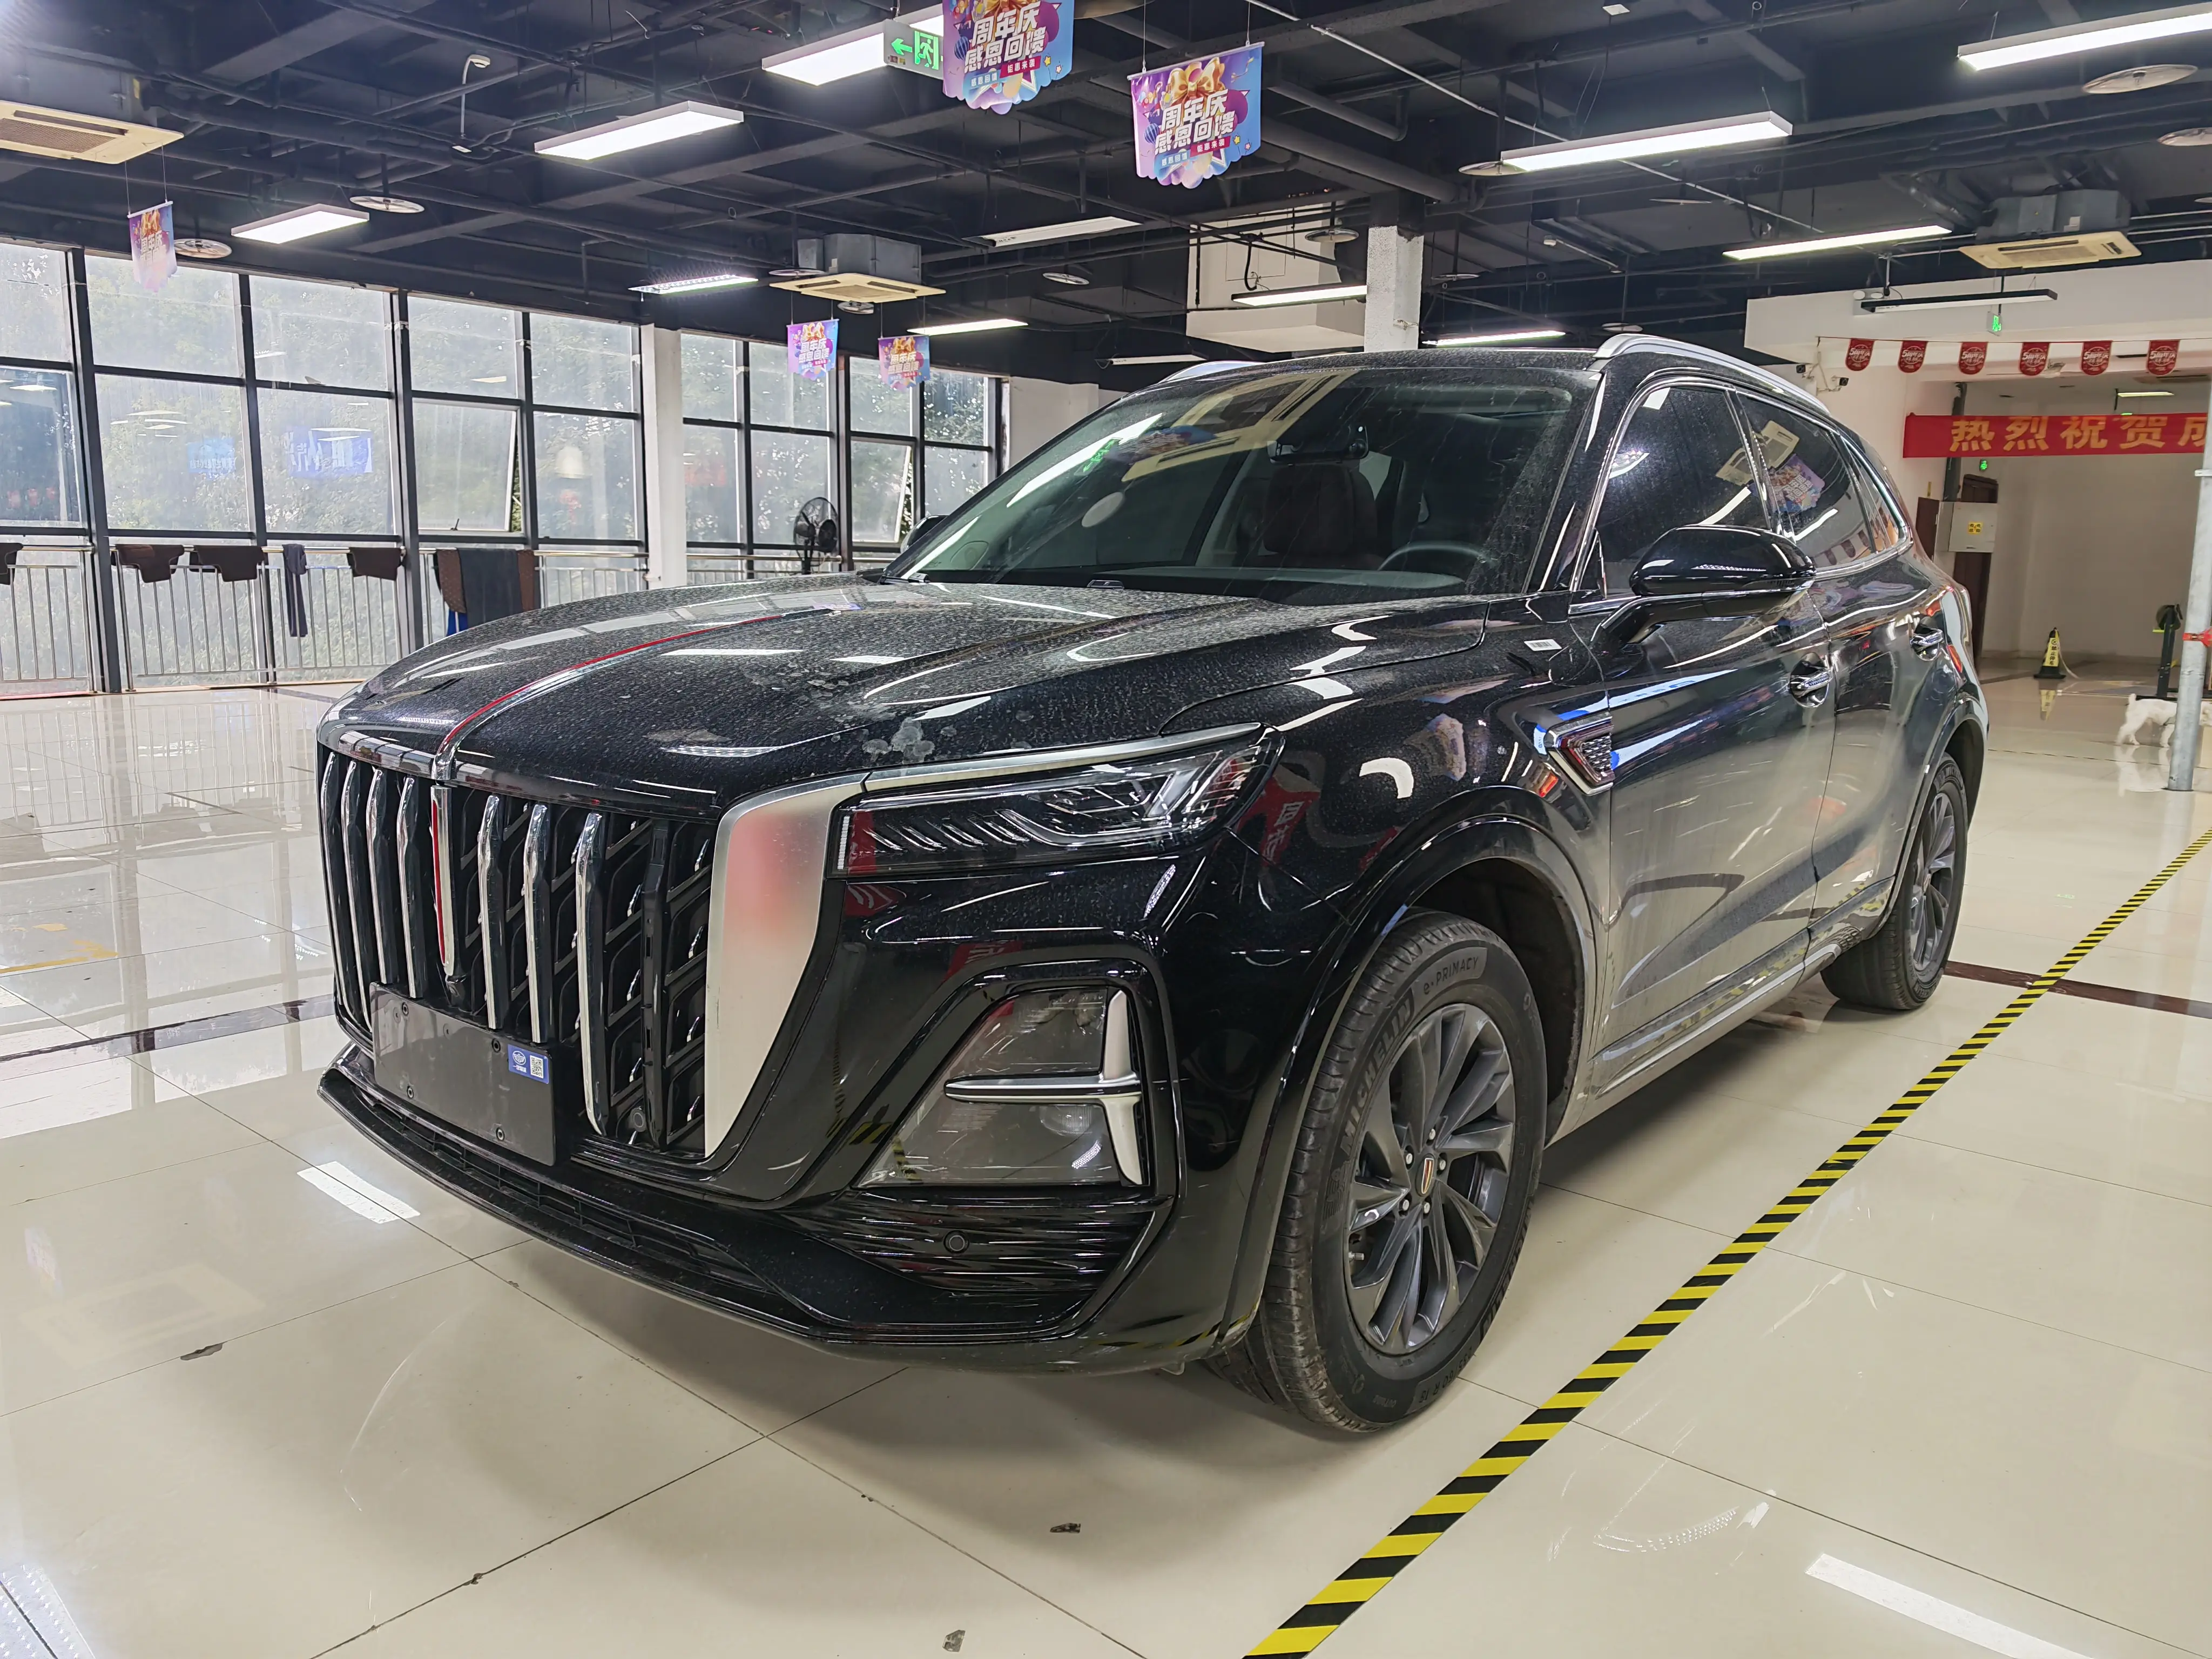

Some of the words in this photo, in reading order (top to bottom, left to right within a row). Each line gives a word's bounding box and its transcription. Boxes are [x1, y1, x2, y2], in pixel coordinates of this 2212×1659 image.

[972, 1, 1041, 48] 周年庆
[964, 26, 1047, 73] 感恩回馈
[1007, 59, 1036, 73] 钜惠来袭
[1161, 89, 1228, 132] 周年庆
[1154, 111, 1236, 156] 感恩回馈
[1197, 139, 1225, 153] 钜惠来袭
[1340, 998, 1414, 1156] MICHELIN
